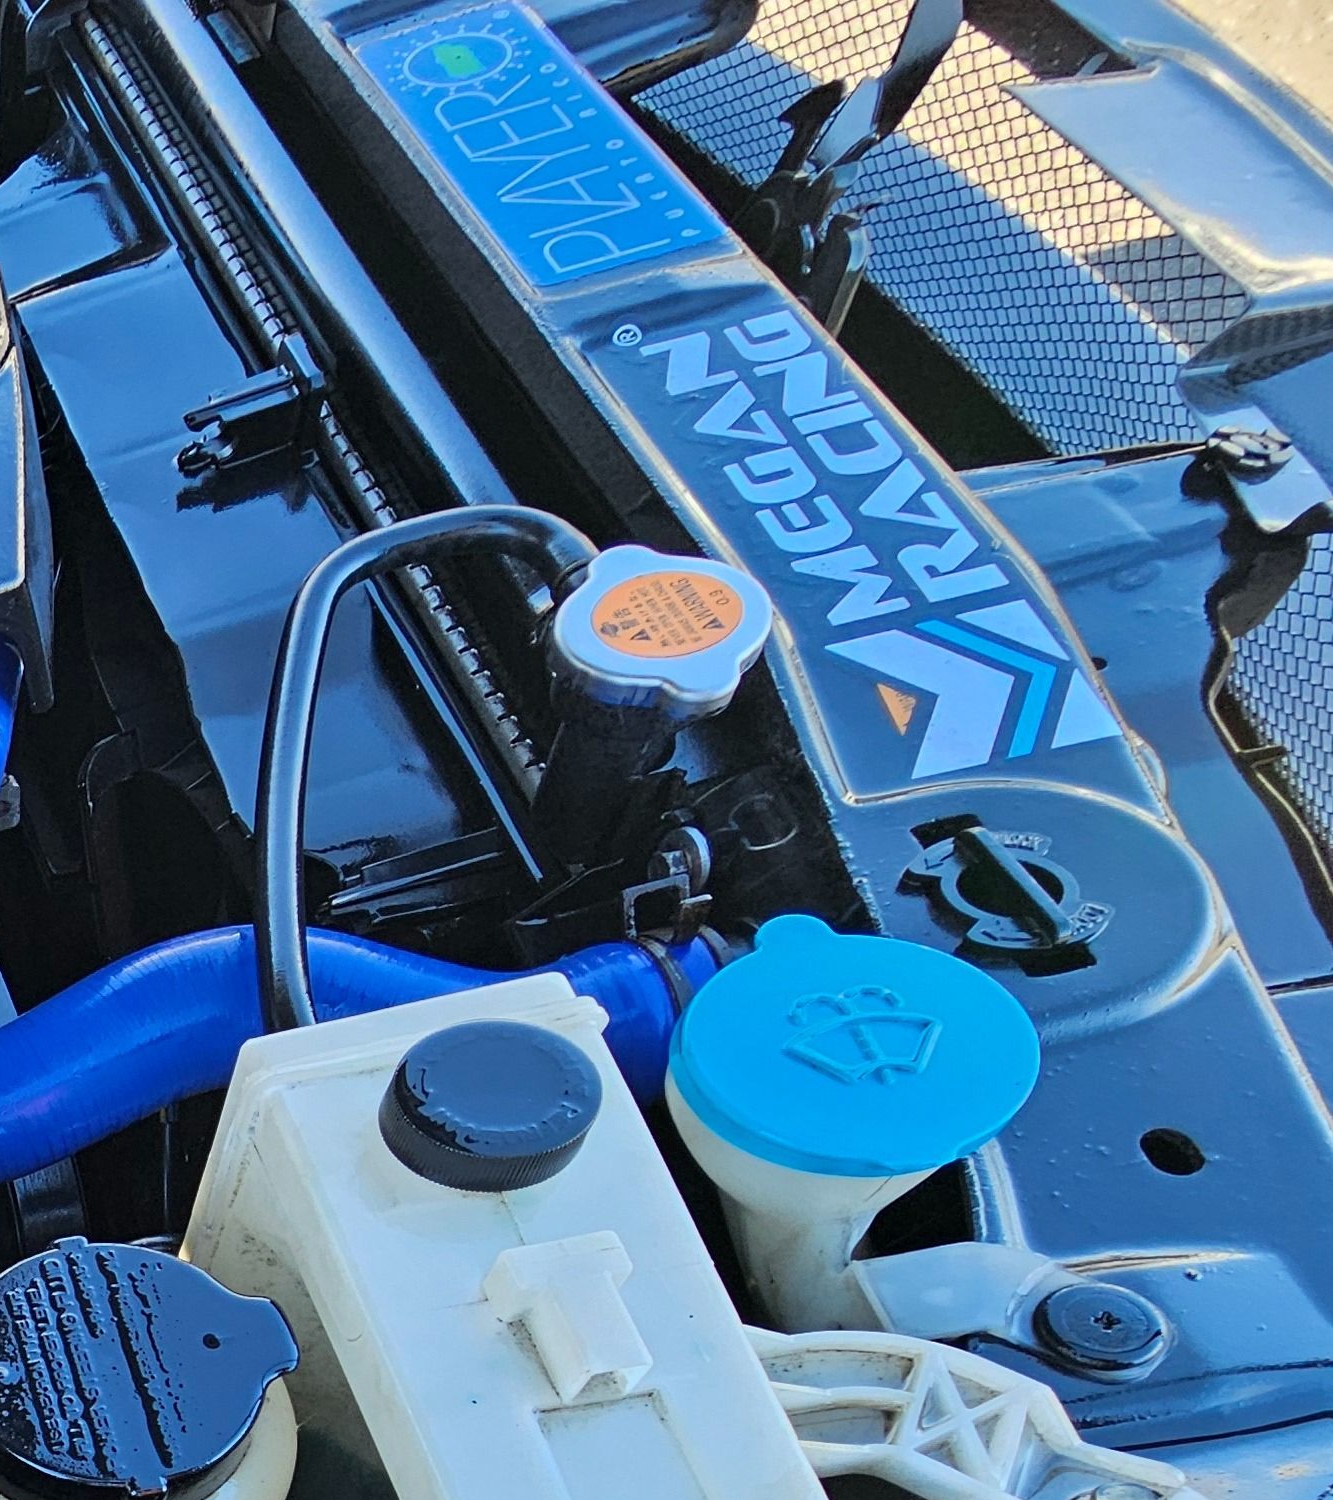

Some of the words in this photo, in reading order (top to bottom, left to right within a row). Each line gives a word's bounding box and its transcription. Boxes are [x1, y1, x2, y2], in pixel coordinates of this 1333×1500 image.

[540, 62, 598, 118] RICO
[605, 138, 702, 238] PUERTO
[639, 330, 911, 627] MEGAN
[723, 309, 1011, 603] RACING
[670, 577, 715, 622] WARNING
